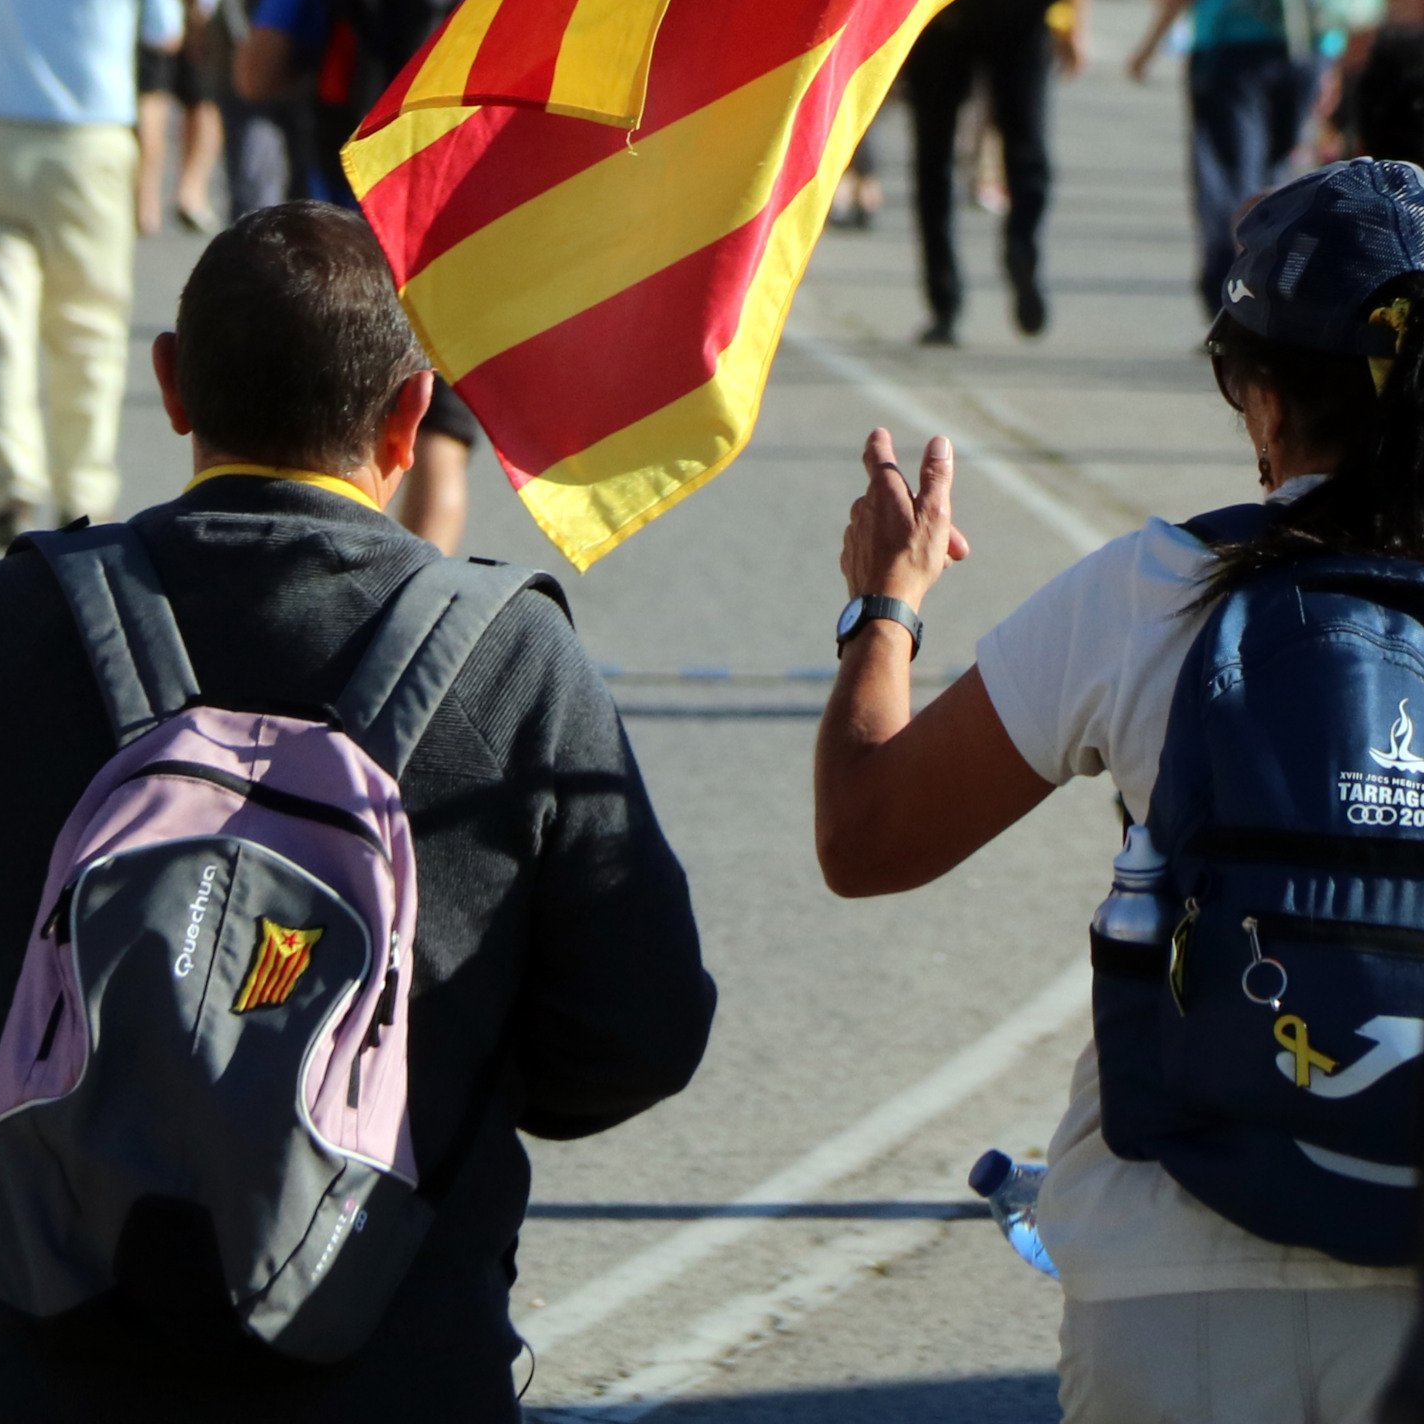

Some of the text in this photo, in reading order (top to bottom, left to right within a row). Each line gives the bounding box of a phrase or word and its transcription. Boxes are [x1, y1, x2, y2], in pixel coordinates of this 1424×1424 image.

[1339, 771, 1363, 781] XVIII
[1365, 773, 1391, 786] JOCS
[174, 864, 218, 978] Quechua
